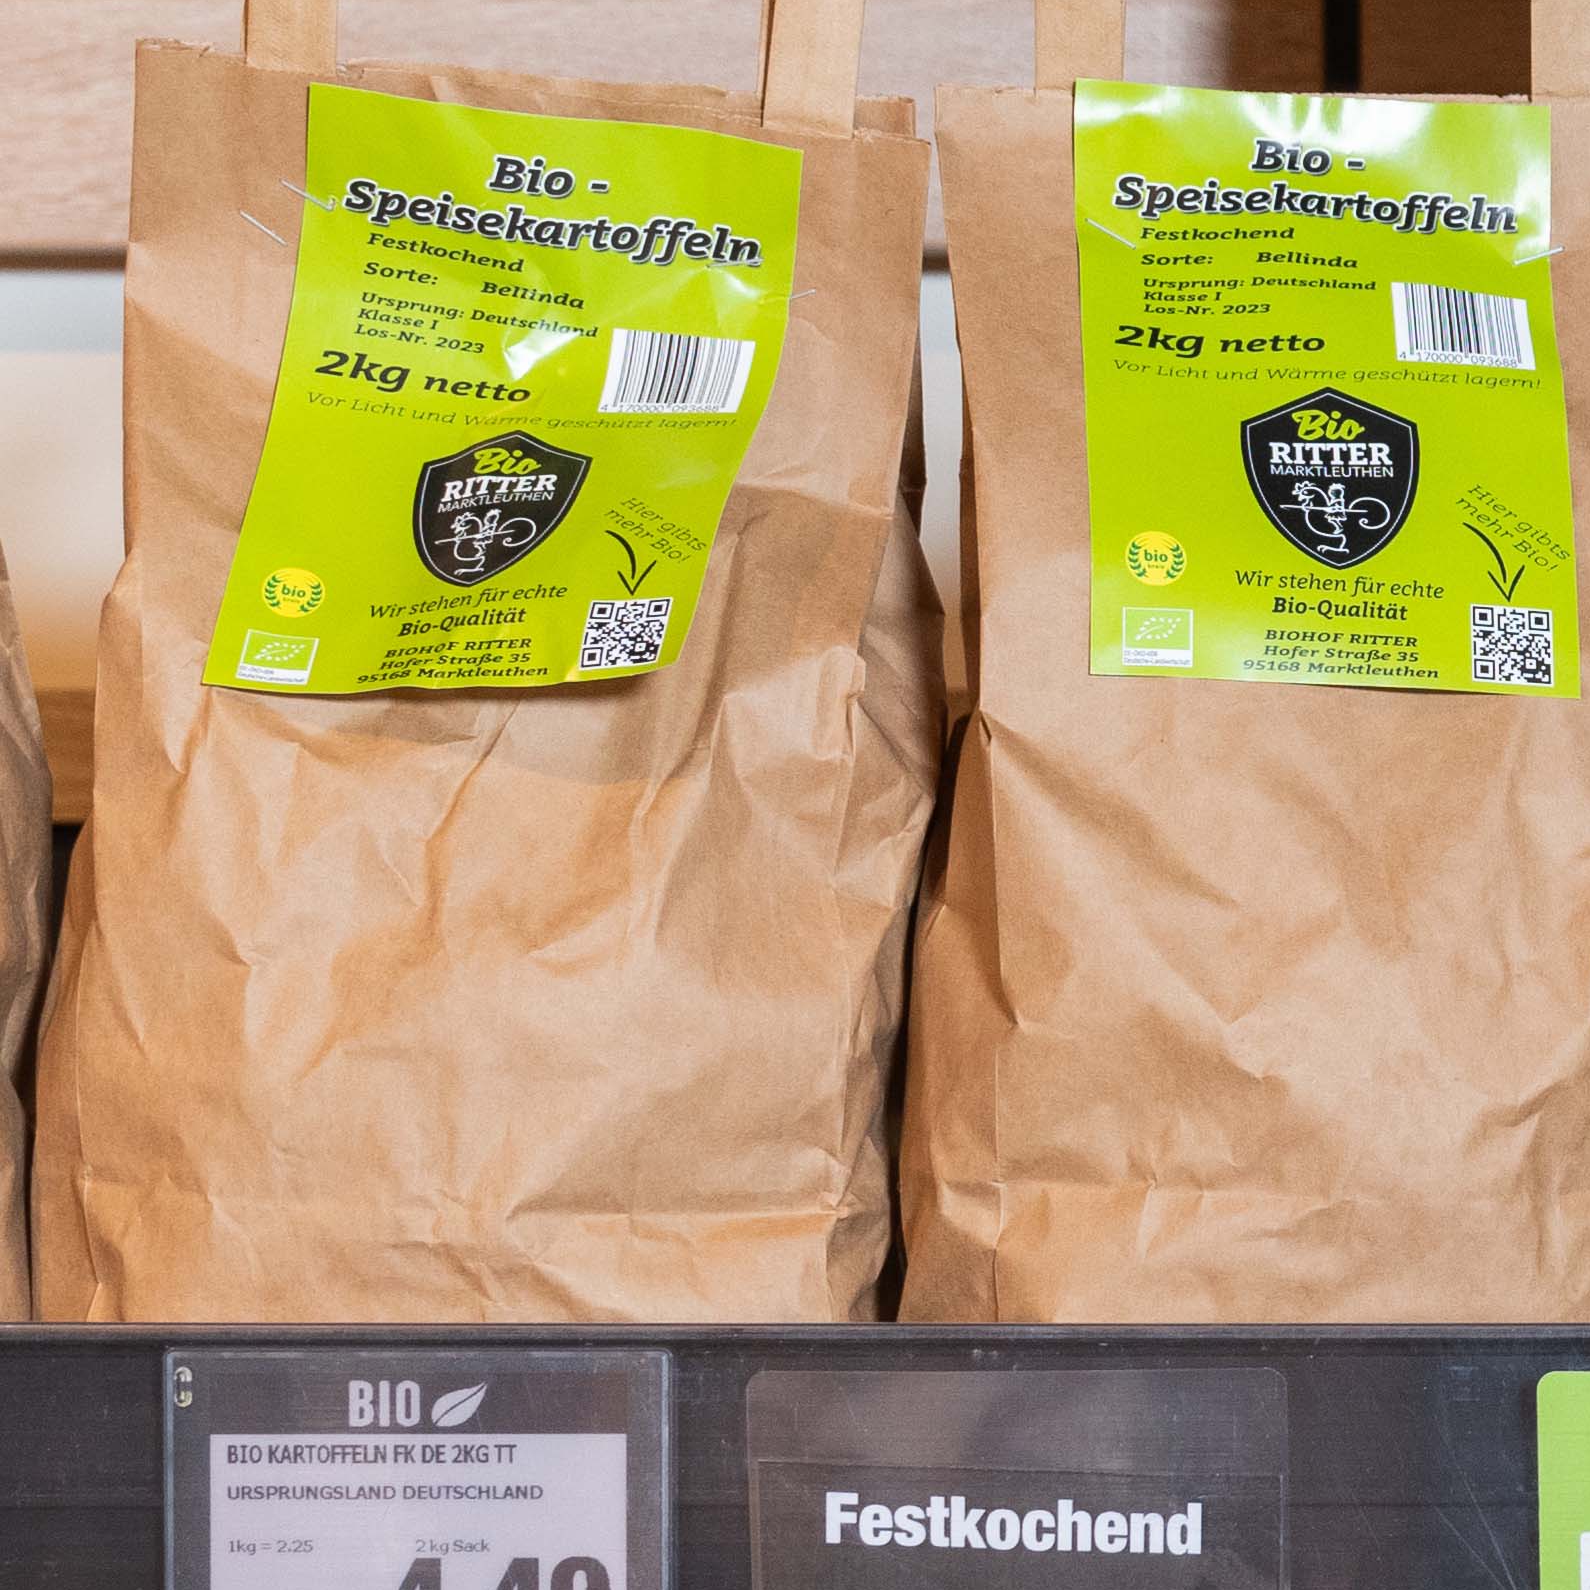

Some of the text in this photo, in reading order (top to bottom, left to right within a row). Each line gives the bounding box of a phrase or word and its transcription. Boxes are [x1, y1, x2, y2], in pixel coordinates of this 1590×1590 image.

[1250, 138, 1331, 175] Bio
[488, 155, 574, 198] Bio
[1113, 175, 1518, 234] Speisekartoffeln
[344, 179, 762, 268] Speisekartoffeln
[1139, 227, 1295, 241] Festkochend
[367, 232, 524, 274] Festkochend
[1141, 251, 1358, 268] Sorte: Bellinda
[363, 262, 585, 311] Sorte: Bellinda
[1144, 277, 1377, 291] Ursprung: Deutschland
[1144, 291, 1209, 301] Klasse
[1144, 303, 1271, 315] Los-Nr. 2023
[1114, 324, 1325, 359] 2kg netto
[314, 349, 531, 403] 2kg netto
[1114, 359, 1541, 389] Vor Licht und Wärme geschützt lagern!
[1291, 409, 1365, 441] Bio
[473, 447, 542, 476] Bio
[1269, 441, 1393, 466] RITTER
[1270, 464, 1394, 478] MARKTLEUTHEN
[437, 490, 553, 513] MARKTLEUTHEN
[441, 474, 557, 503] RITTER
[1455, 497, 1514, 539] mehr
[1467, 484, 1570, 561] Hier gibts
[1144, 548, 1168, 563] bio
[1235, 570, 1445, 599] Wir stehen für echte
[1272, 596, 1408, 621] Bio-Qualität
[398, 609, 526, 638] Bio-Qualität
[1265, 629, 1418, 647] BIOHOF RITTER
[1264, 645, 1420, 662] Hofer Straße 35
[1243, 659, 1439, 679] 95168 Marktleuthen
[348, 1380, 421, 1427] BIO
[227, 1445, 516, 1463] BIO KARTOFFELN FK DE 2KG TT
[227, 1486, 543, 1500] URSPRUNGSLAND DEUTSCHLAND
[825, 1491, 1202, 1555] Festkochend
[228, 1540, 256, 1555] 1kg
[277, 1540, 313, 1552] 2.25
[429, 1540, 449, 1555] kg
[453, 1540, 490, 1552] Sack
